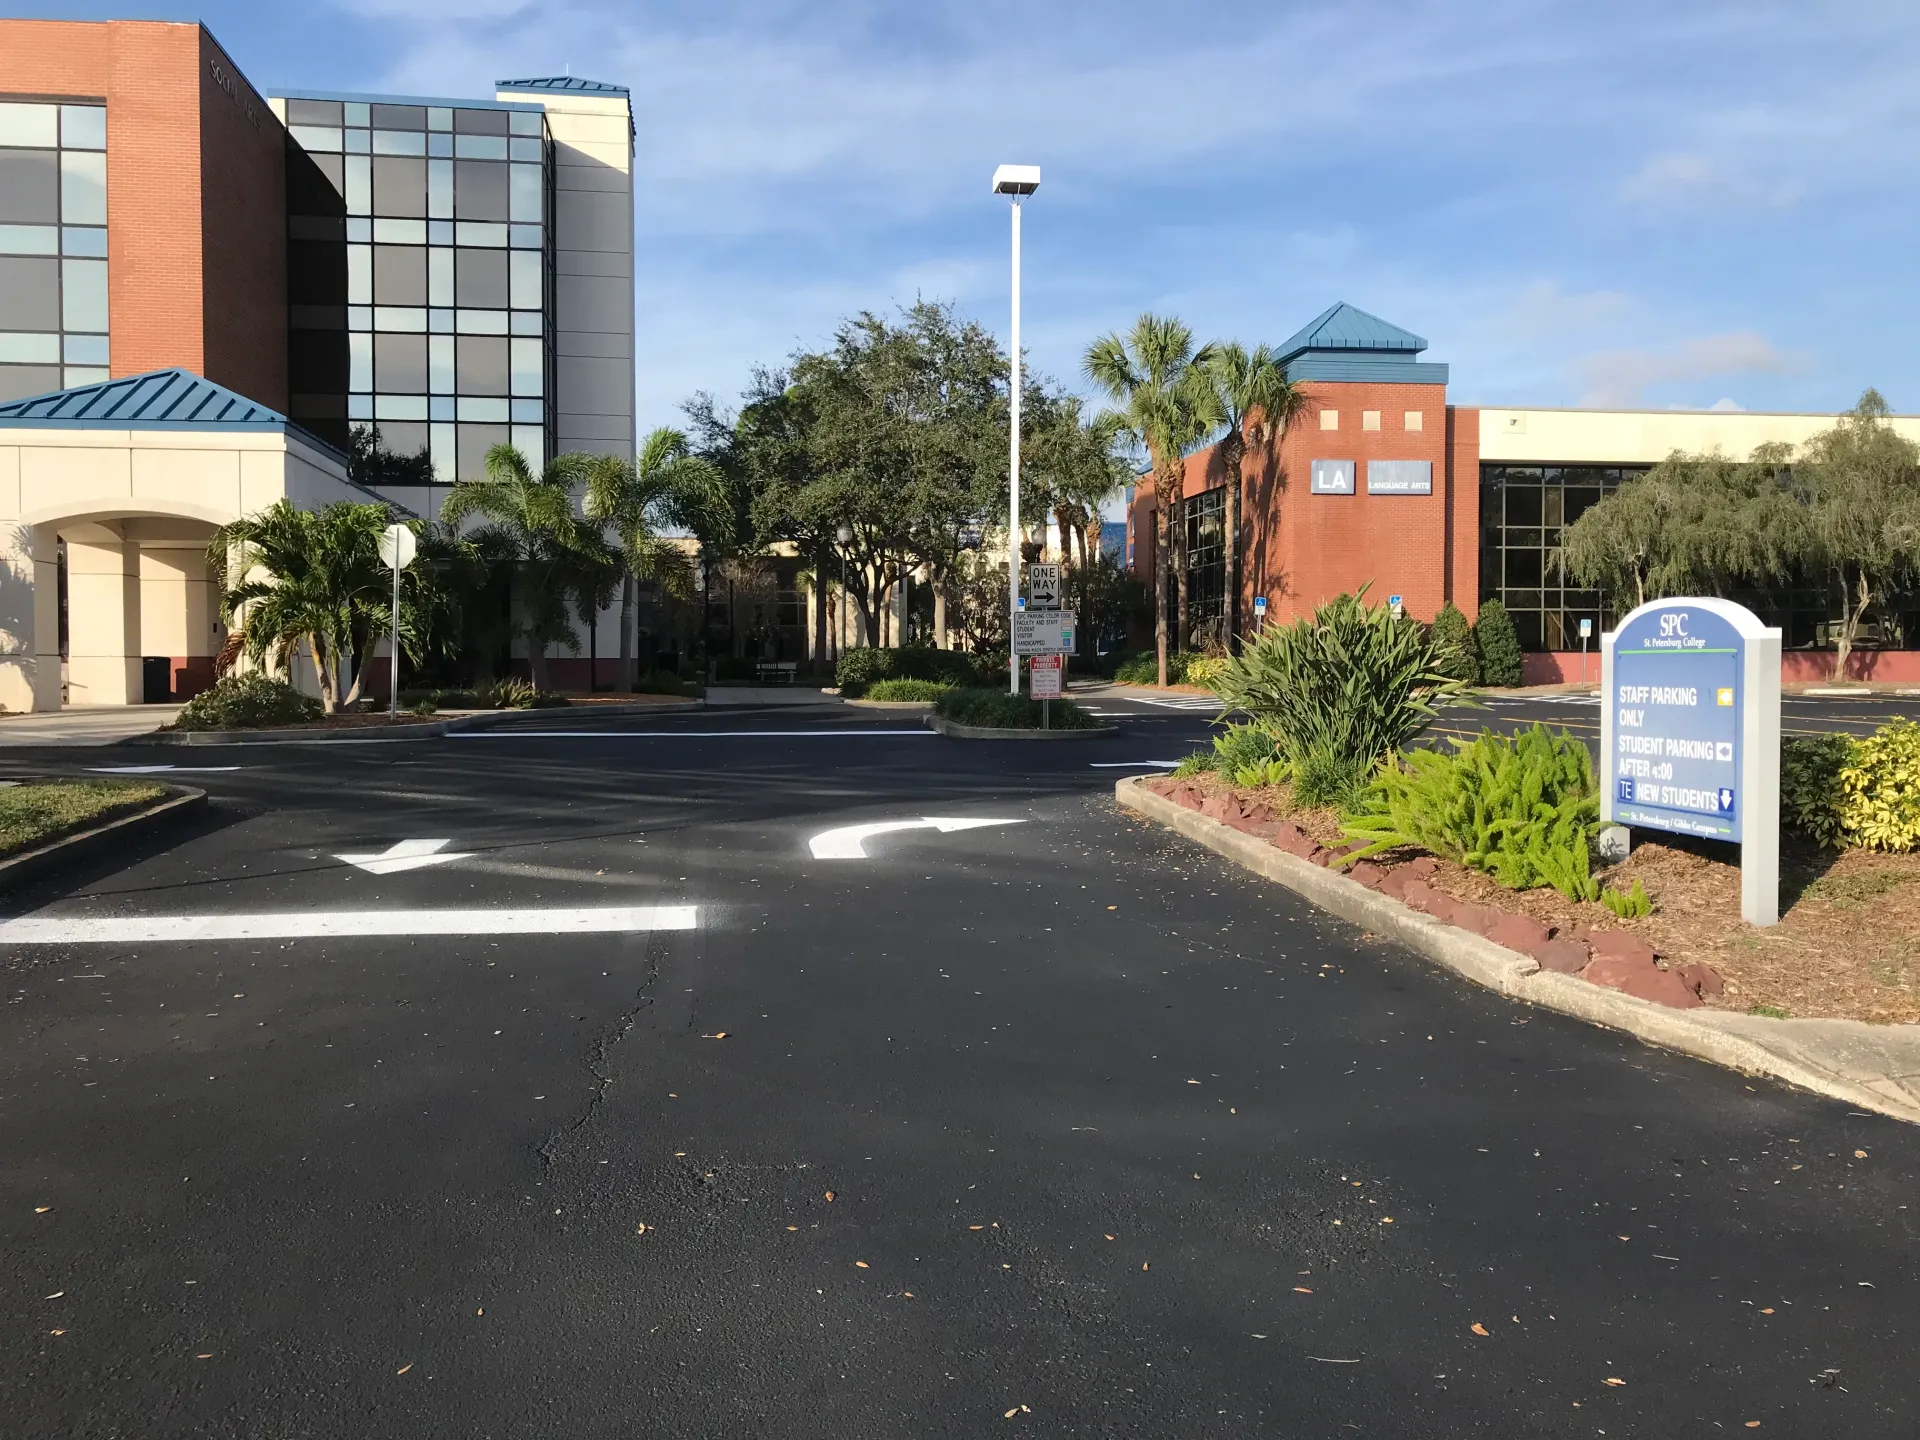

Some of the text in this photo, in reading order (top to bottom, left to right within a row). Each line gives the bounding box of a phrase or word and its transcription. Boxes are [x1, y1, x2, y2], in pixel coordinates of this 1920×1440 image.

[210, 60, 239, 107] SOCIAL
[1318, 470, 1347, 489] LA
[1033, 568, 1056, 578] ONE
[1033, 580, 1056, 590] WAY
[1660, 613, 1688, 637] SPC
[1652, 637, 1682, 649] Petersburg
[1683, 636, 1706, 649] College
[1619, 686, 1697, 706] STAFF PARKING
[1619, 709, 1644, 728] ONLY
[1619, 737, 1714, 761] STUDENT PARKING
[1619, 758, 1673, 780] AFTER 4:00
[1620, 780, 1719, 811] TE NEW STUDENTS
[1630, 812, 1638, 821] St.
[1639, 813, 1669, 829] Petersburg
[1674, 818, 1691, 830] Gibbs
[1692, 821, 1718, 836] Campus
